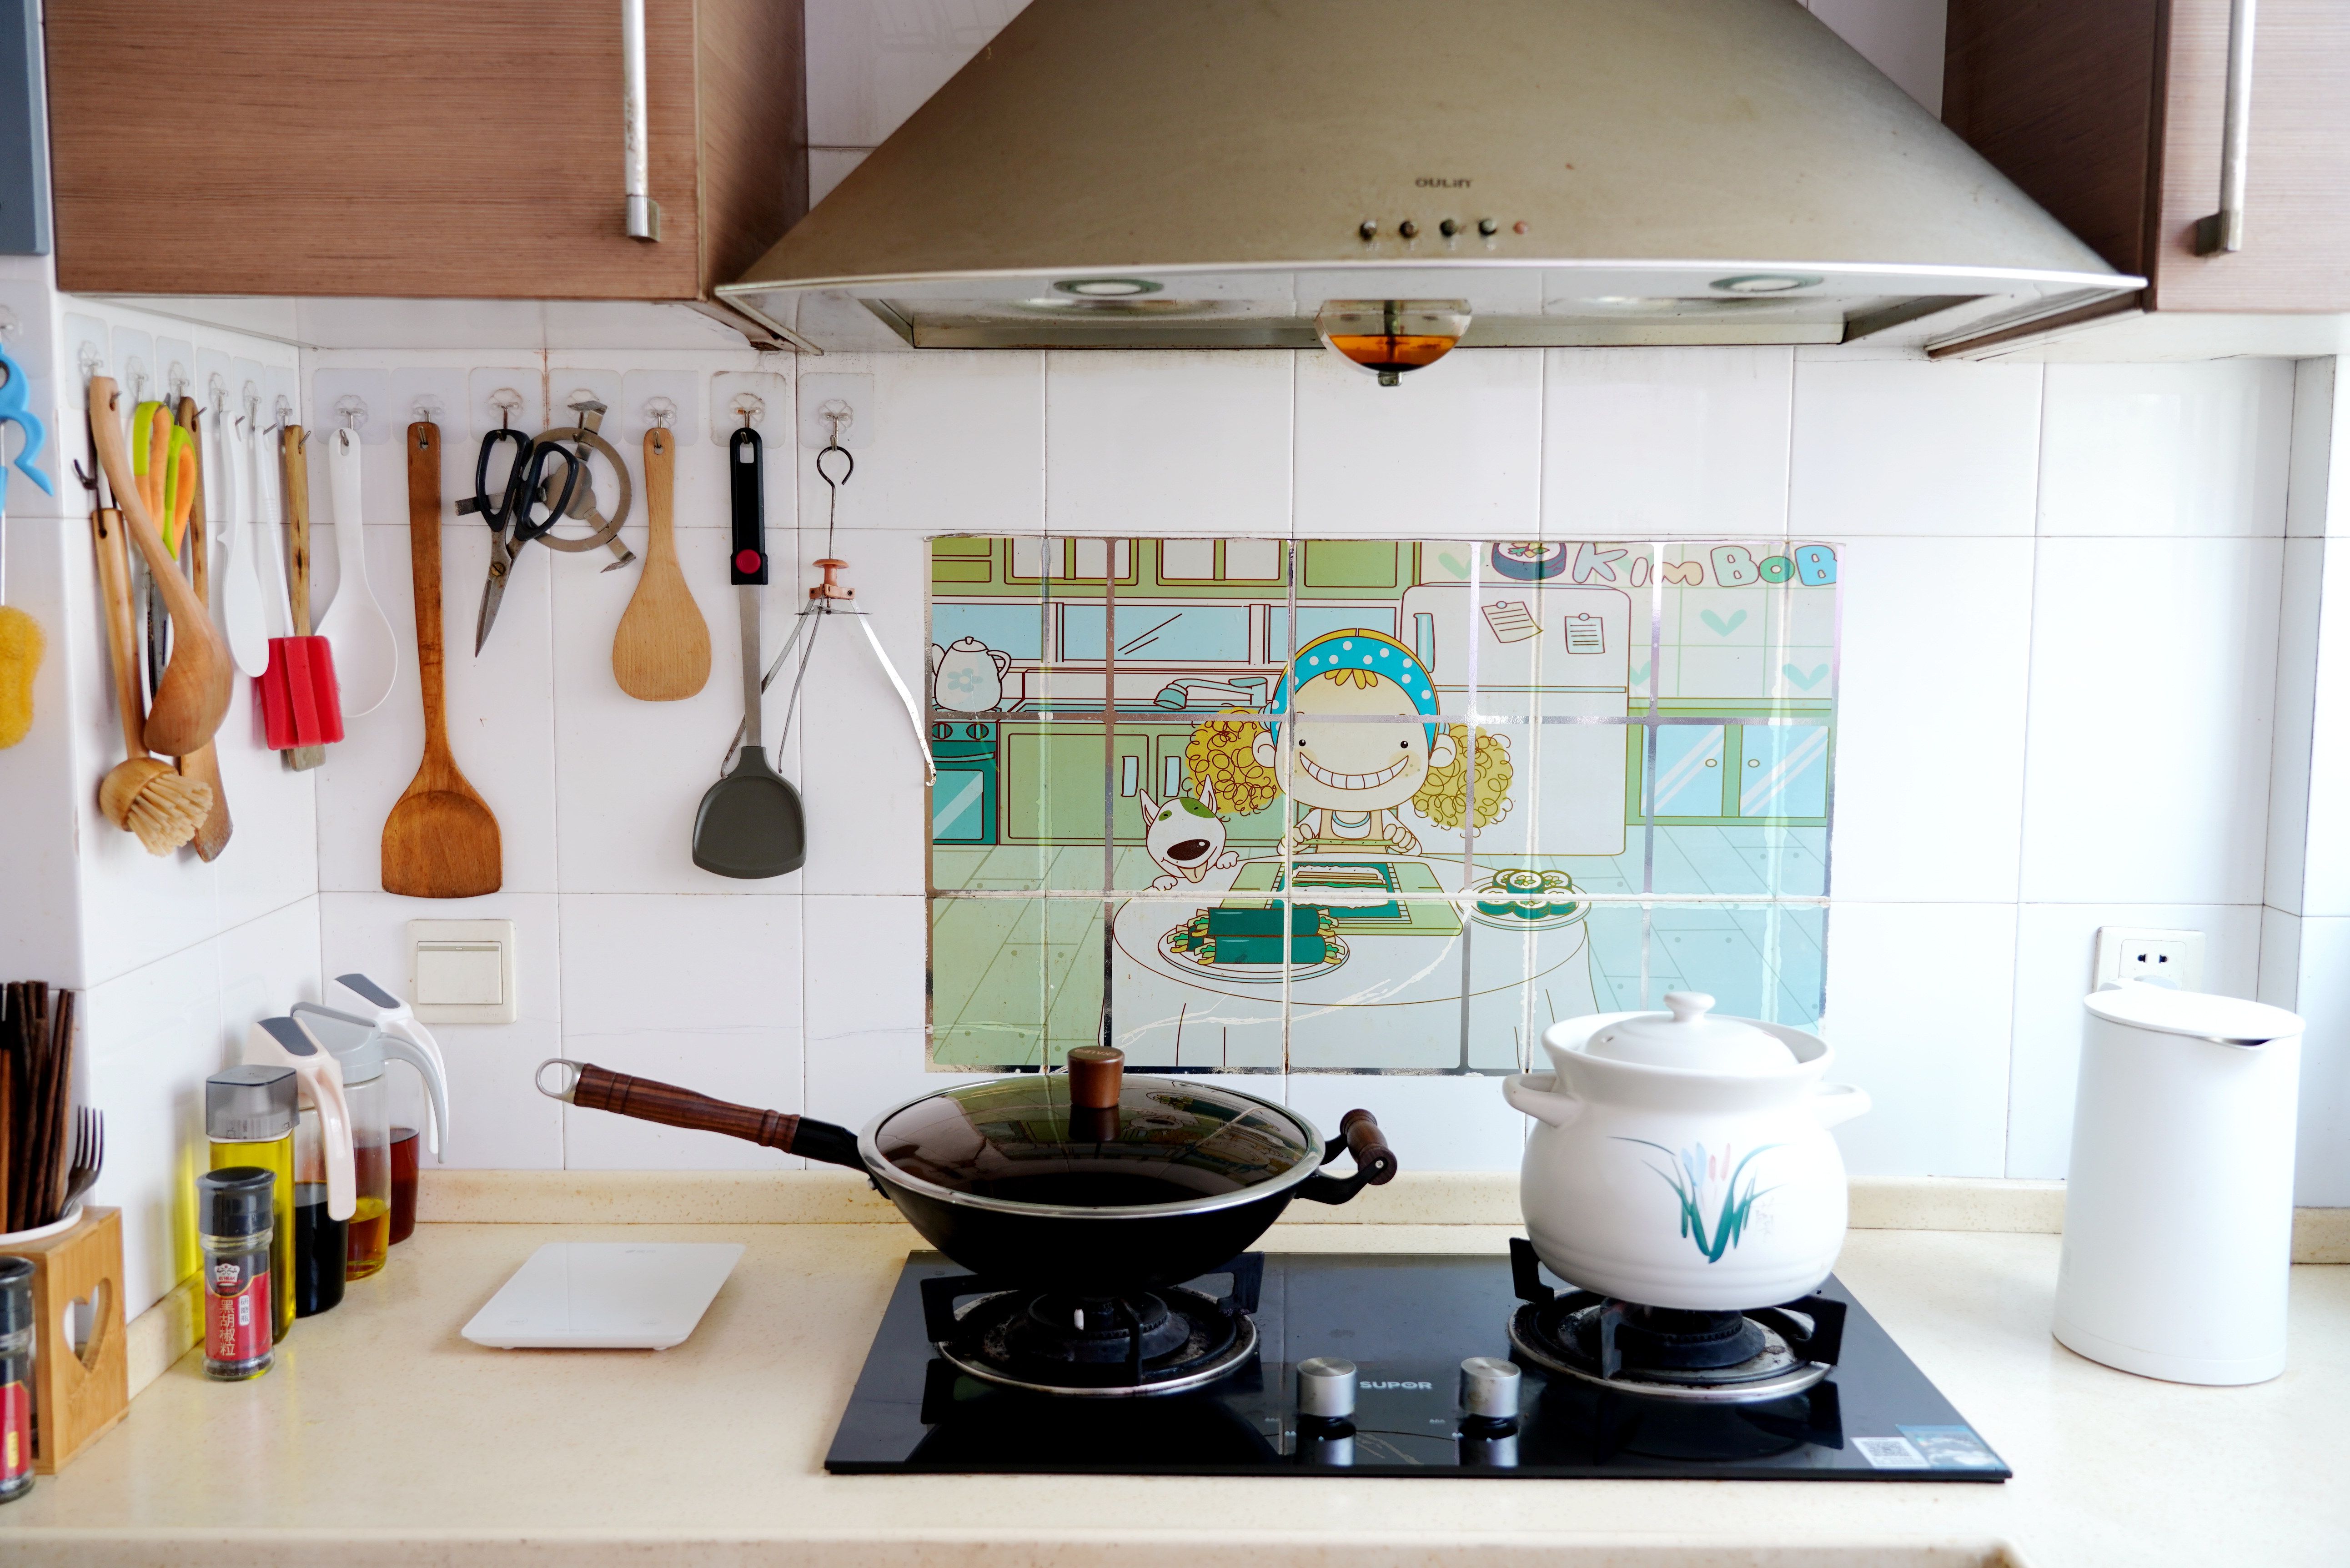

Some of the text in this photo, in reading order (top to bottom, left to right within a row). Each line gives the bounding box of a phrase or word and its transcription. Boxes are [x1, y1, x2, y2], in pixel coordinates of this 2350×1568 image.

[219, 1299, 236, 1356] 黑胡椒粒
[1360, 1381, 1433, 1390] SUPOR
